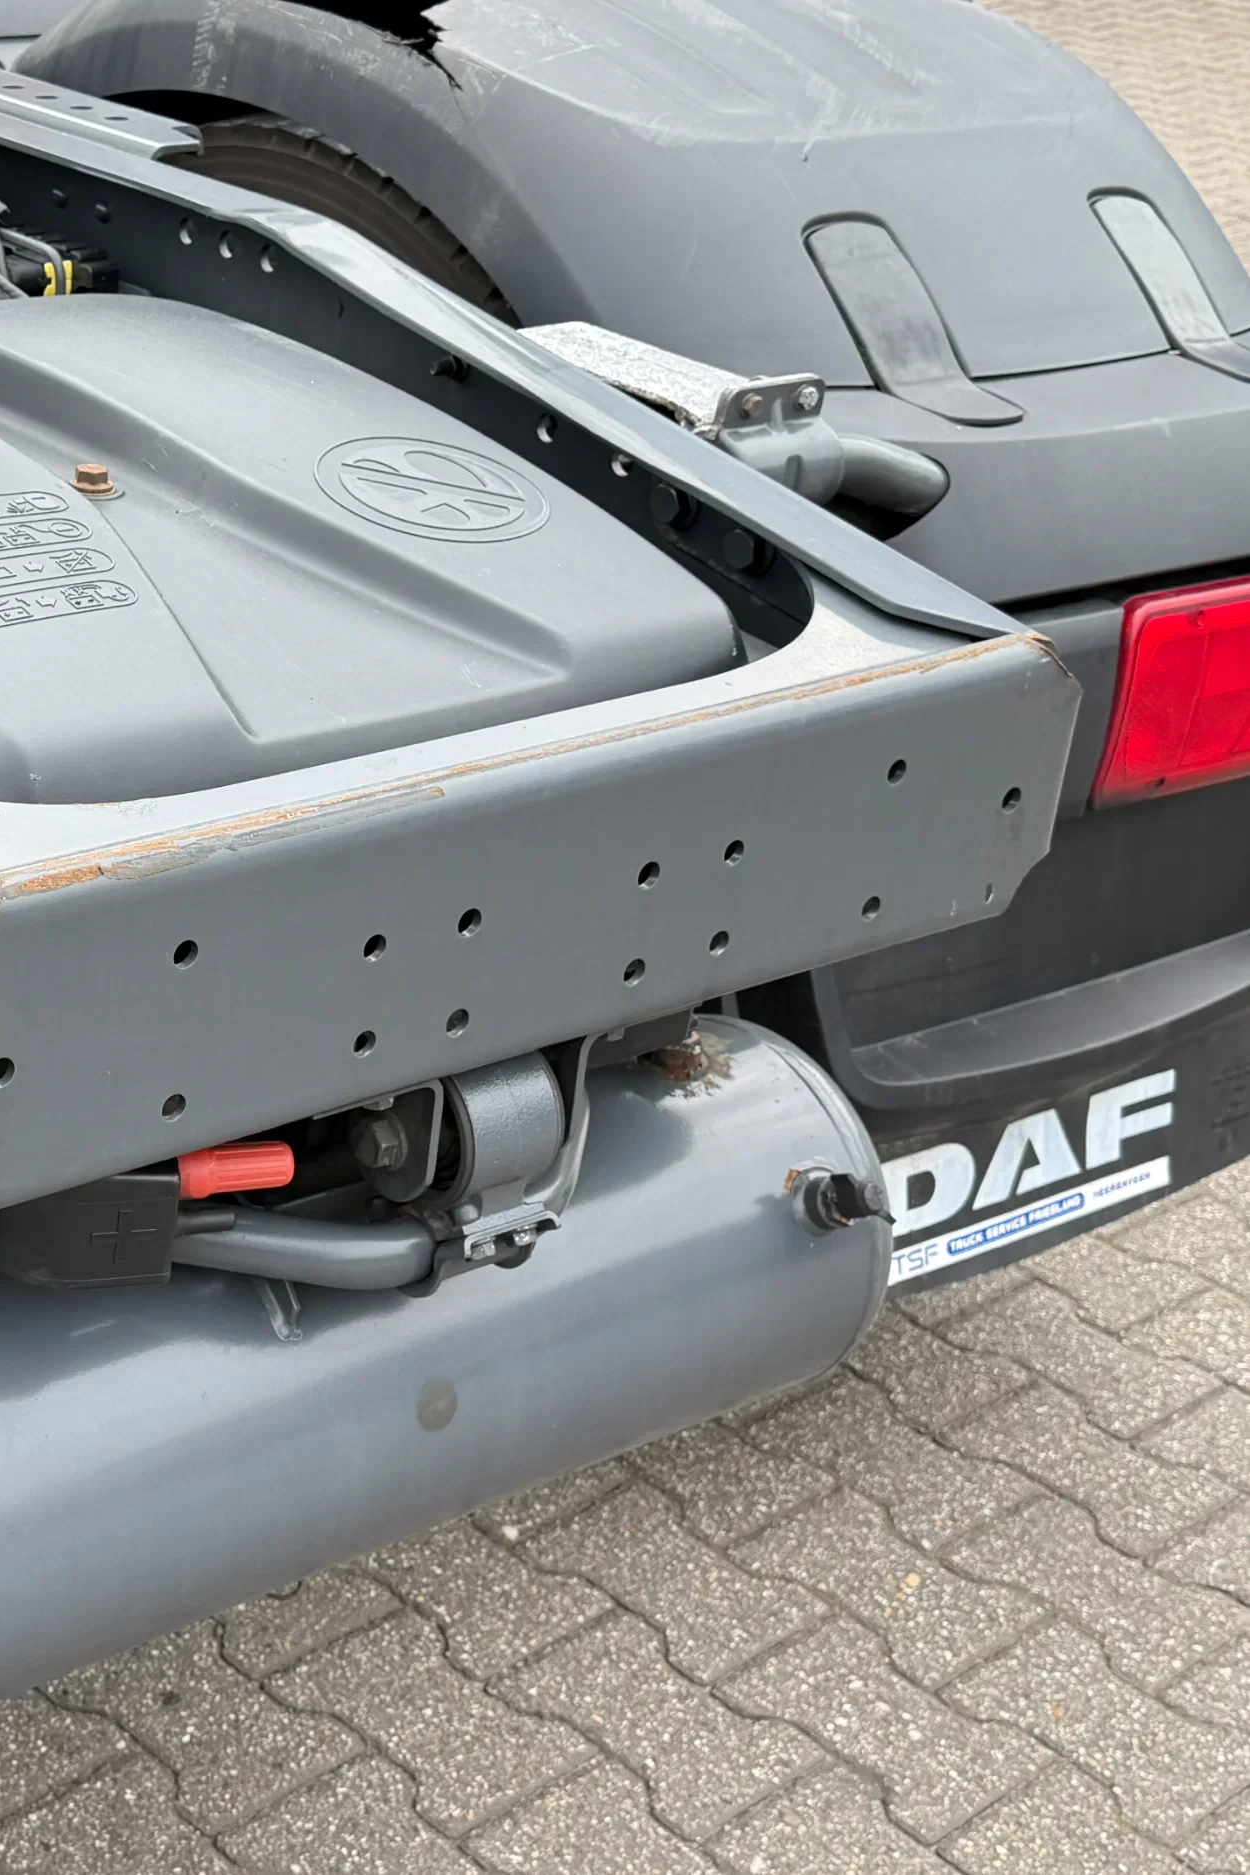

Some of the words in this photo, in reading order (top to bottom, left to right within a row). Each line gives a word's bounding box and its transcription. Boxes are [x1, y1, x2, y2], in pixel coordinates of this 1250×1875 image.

[880, 1069, 1177, 1238] DAF
[892, 1243, 938, 1275] TSF
[950, 1232, 984, 1253] TRUCK
[985, 1214, 1027, 1239] SERVICE
[1028, 1194, 1081, 1223] FRIESLAND
